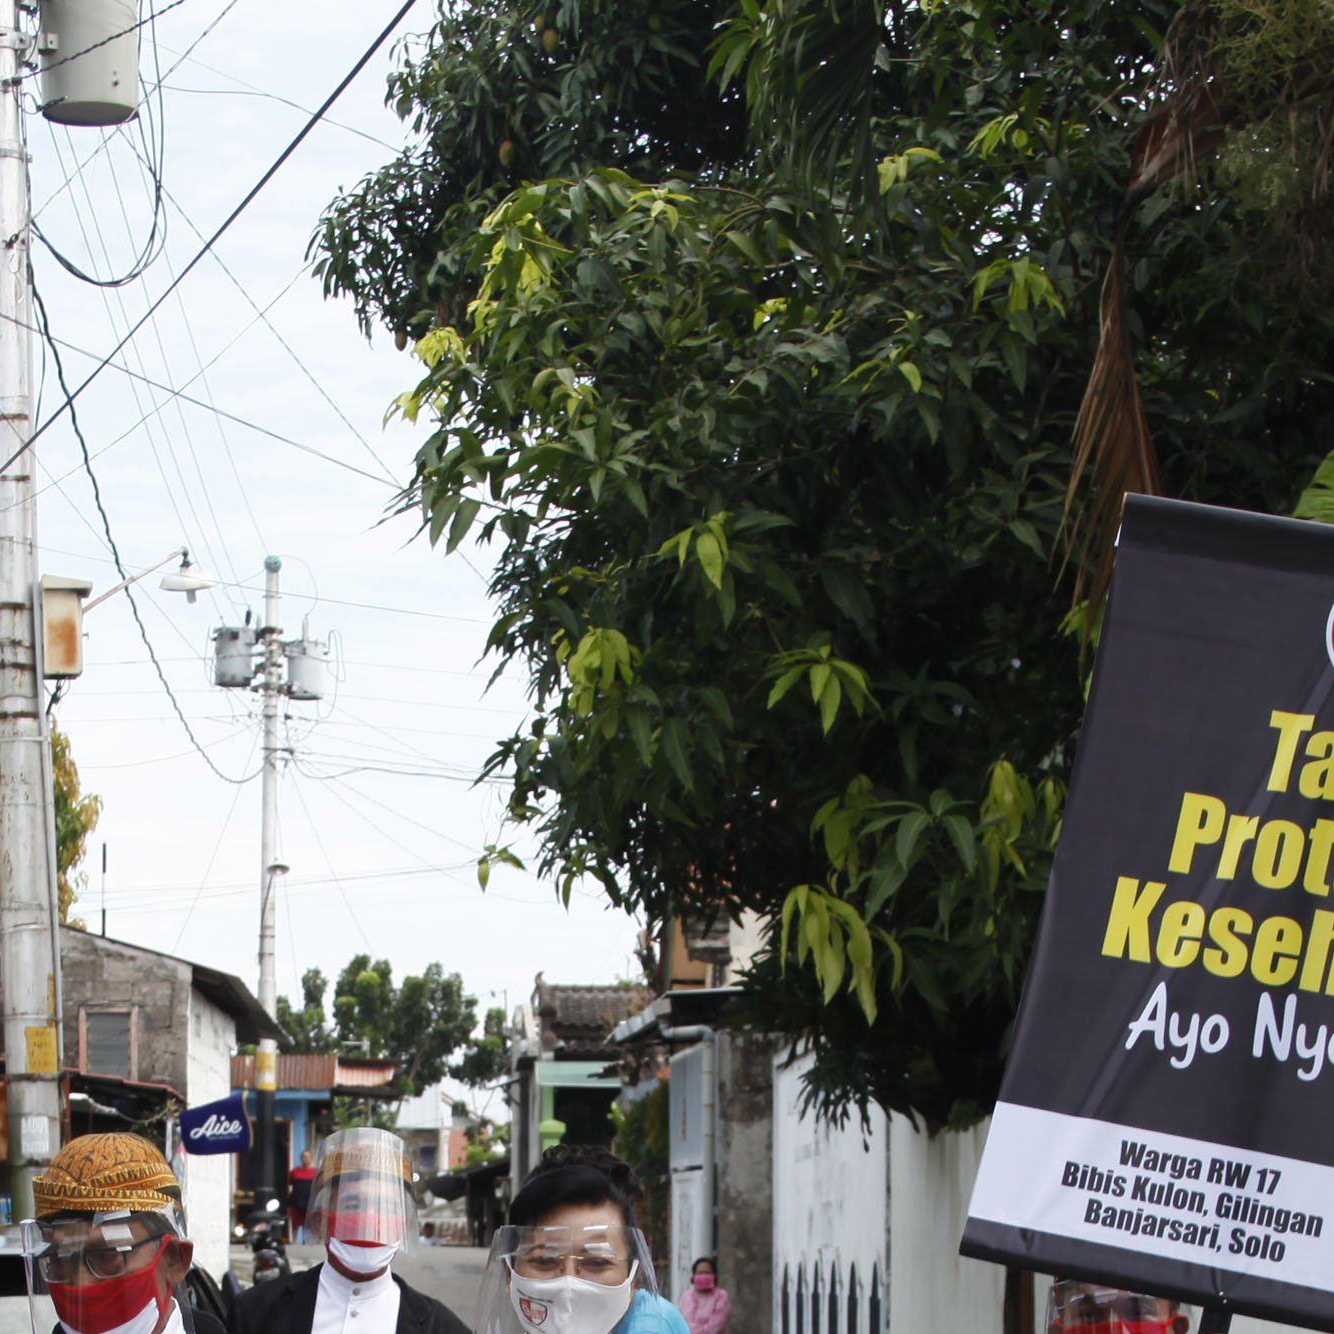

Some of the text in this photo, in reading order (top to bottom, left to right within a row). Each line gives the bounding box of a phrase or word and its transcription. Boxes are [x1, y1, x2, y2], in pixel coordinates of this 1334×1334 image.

[1125, 981, 1229, 1069] Ayo
[190, 1114, 243, 1139] Aice
[1061, 1161, 1324, 1238] Bibis Kulon, Gilingan
[1119, 1140, 1282, 1196] Warga RW 17
[1084, 1198, 1286, 1263] Banjarsari, Solo
